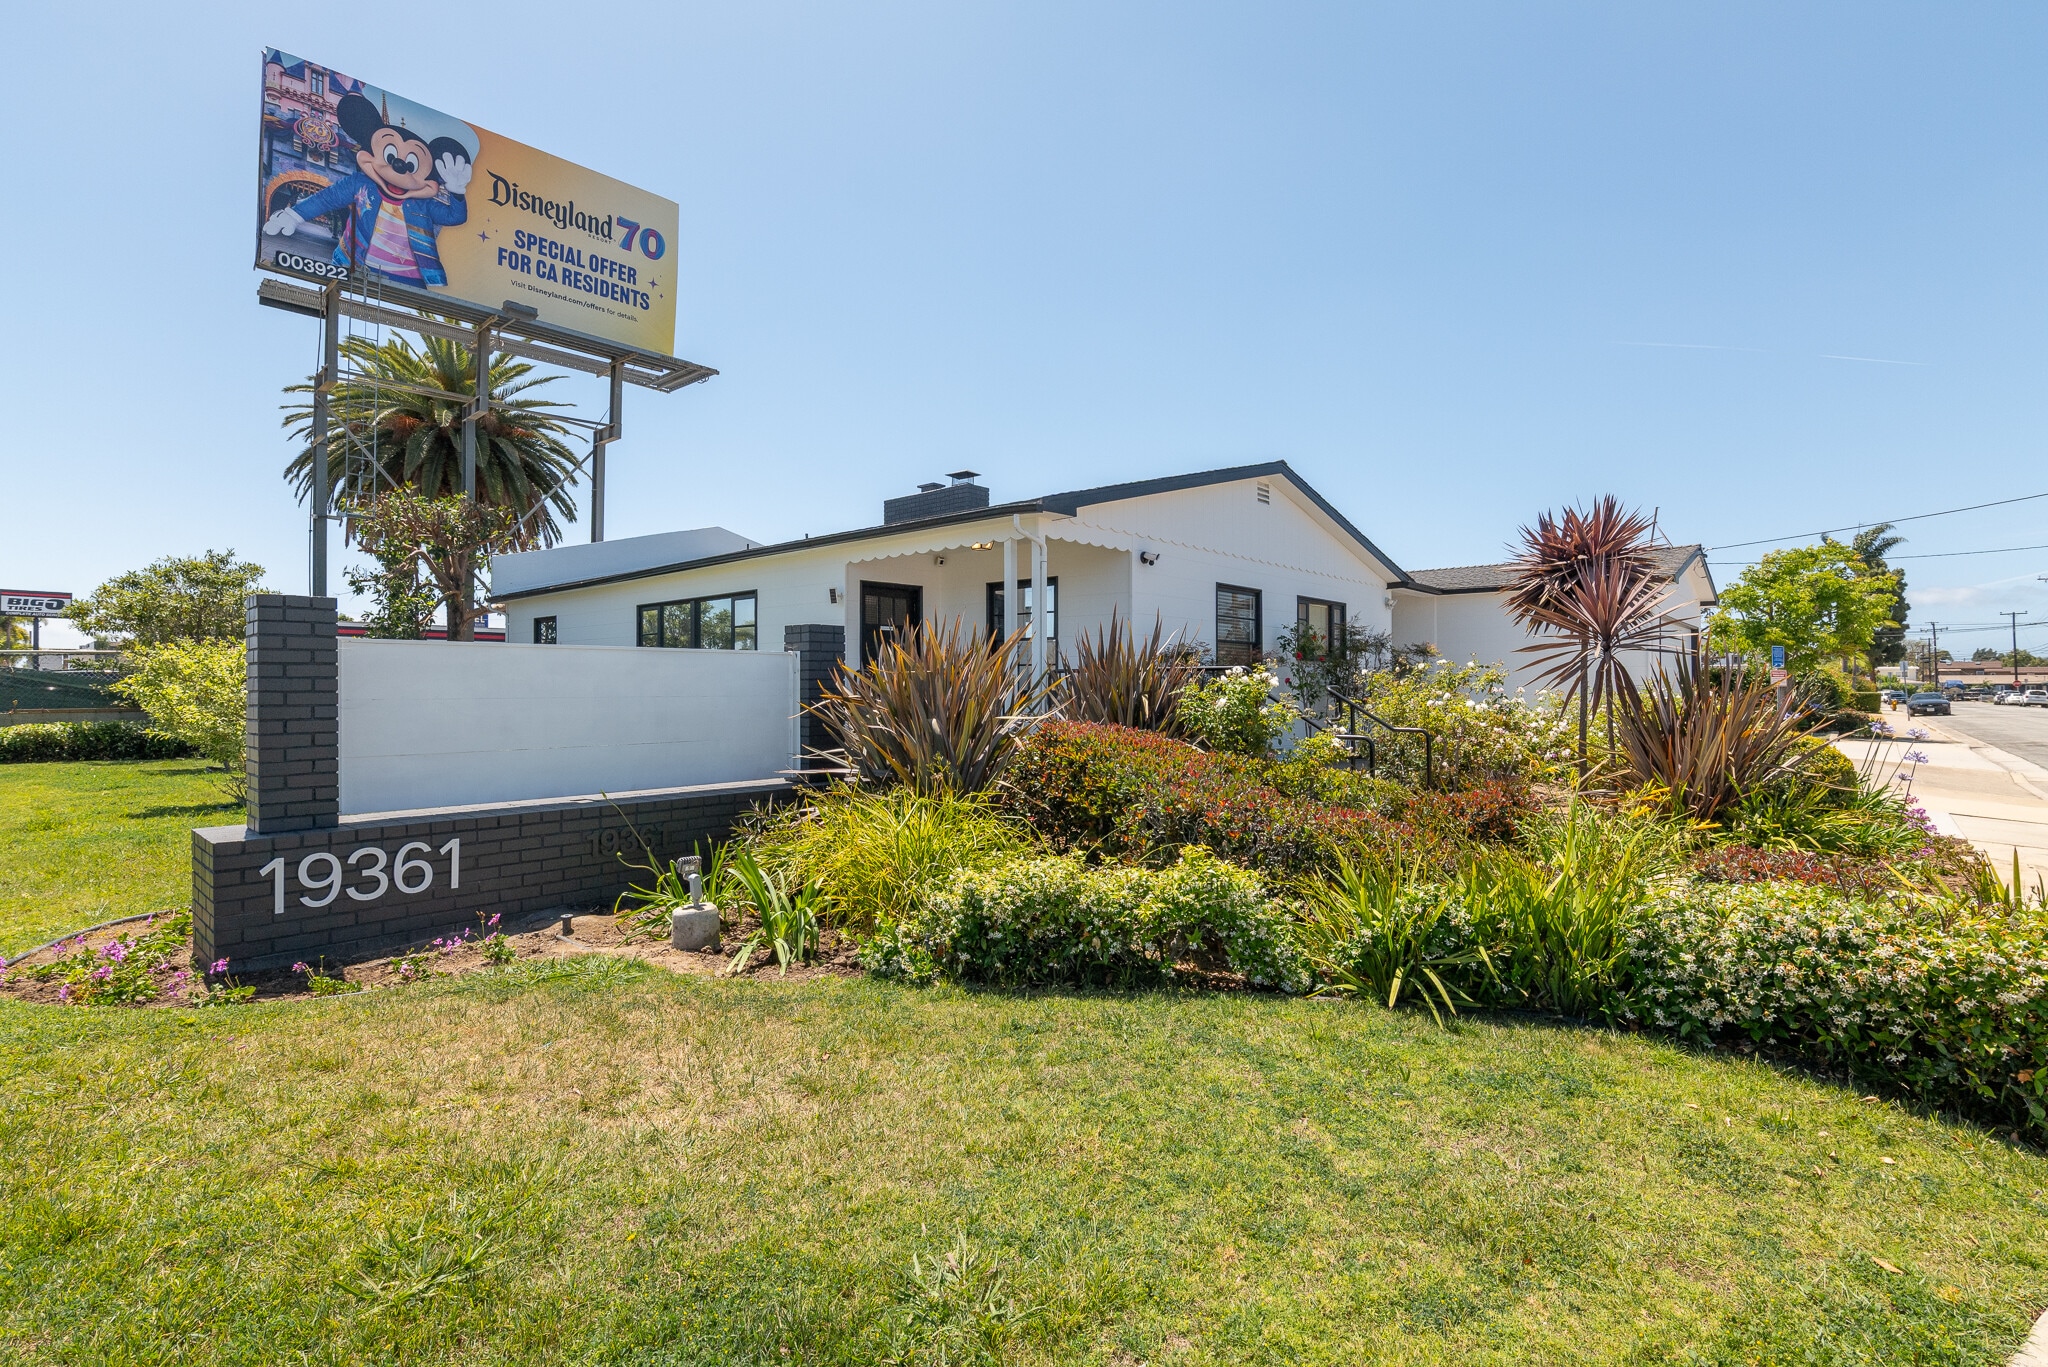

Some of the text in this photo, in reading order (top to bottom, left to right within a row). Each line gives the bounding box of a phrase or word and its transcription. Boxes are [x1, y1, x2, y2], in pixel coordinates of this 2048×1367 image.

[486, 168, 666, 260] Disneyland 70
[513, 229, 637, 286] SPECIAL OFFER
[588, 233, 612, 245] RESORT
[278, 253, 348, 280] 003922
[497, 246, 650, 311] FOR CA RESIDENTS
[510, 279, 639, 323] Visit Disneyland.com/offers for details.
[7, 598, 44, 606] BIG
[584, 824, 673, 858] 19361
[257, 837, 461, 915] 19361
